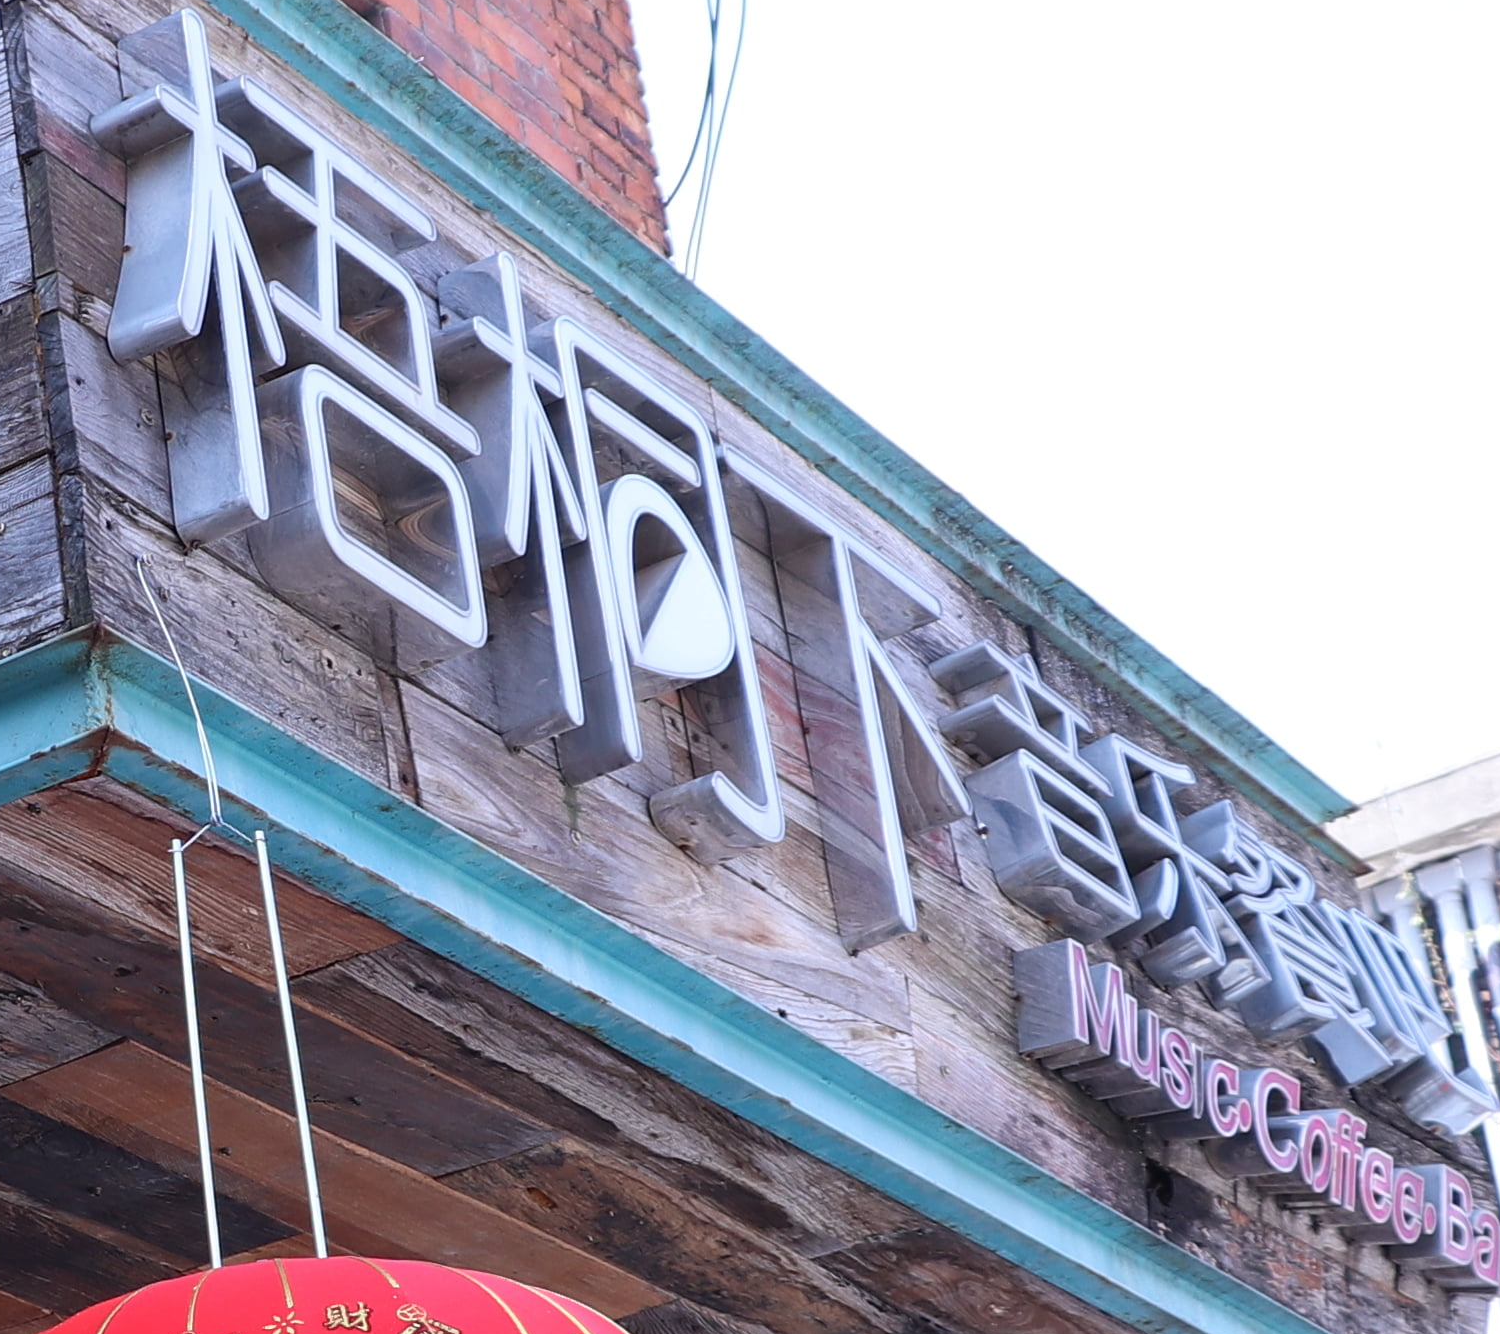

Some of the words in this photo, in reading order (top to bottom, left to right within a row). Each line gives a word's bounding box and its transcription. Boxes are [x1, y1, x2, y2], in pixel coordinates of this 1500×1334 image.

[110, 7, 970, 937] 梧桐下
[960, 637, 1498, 1122] 音乐餐吧
[323, 1301, 371, 1332] 財
